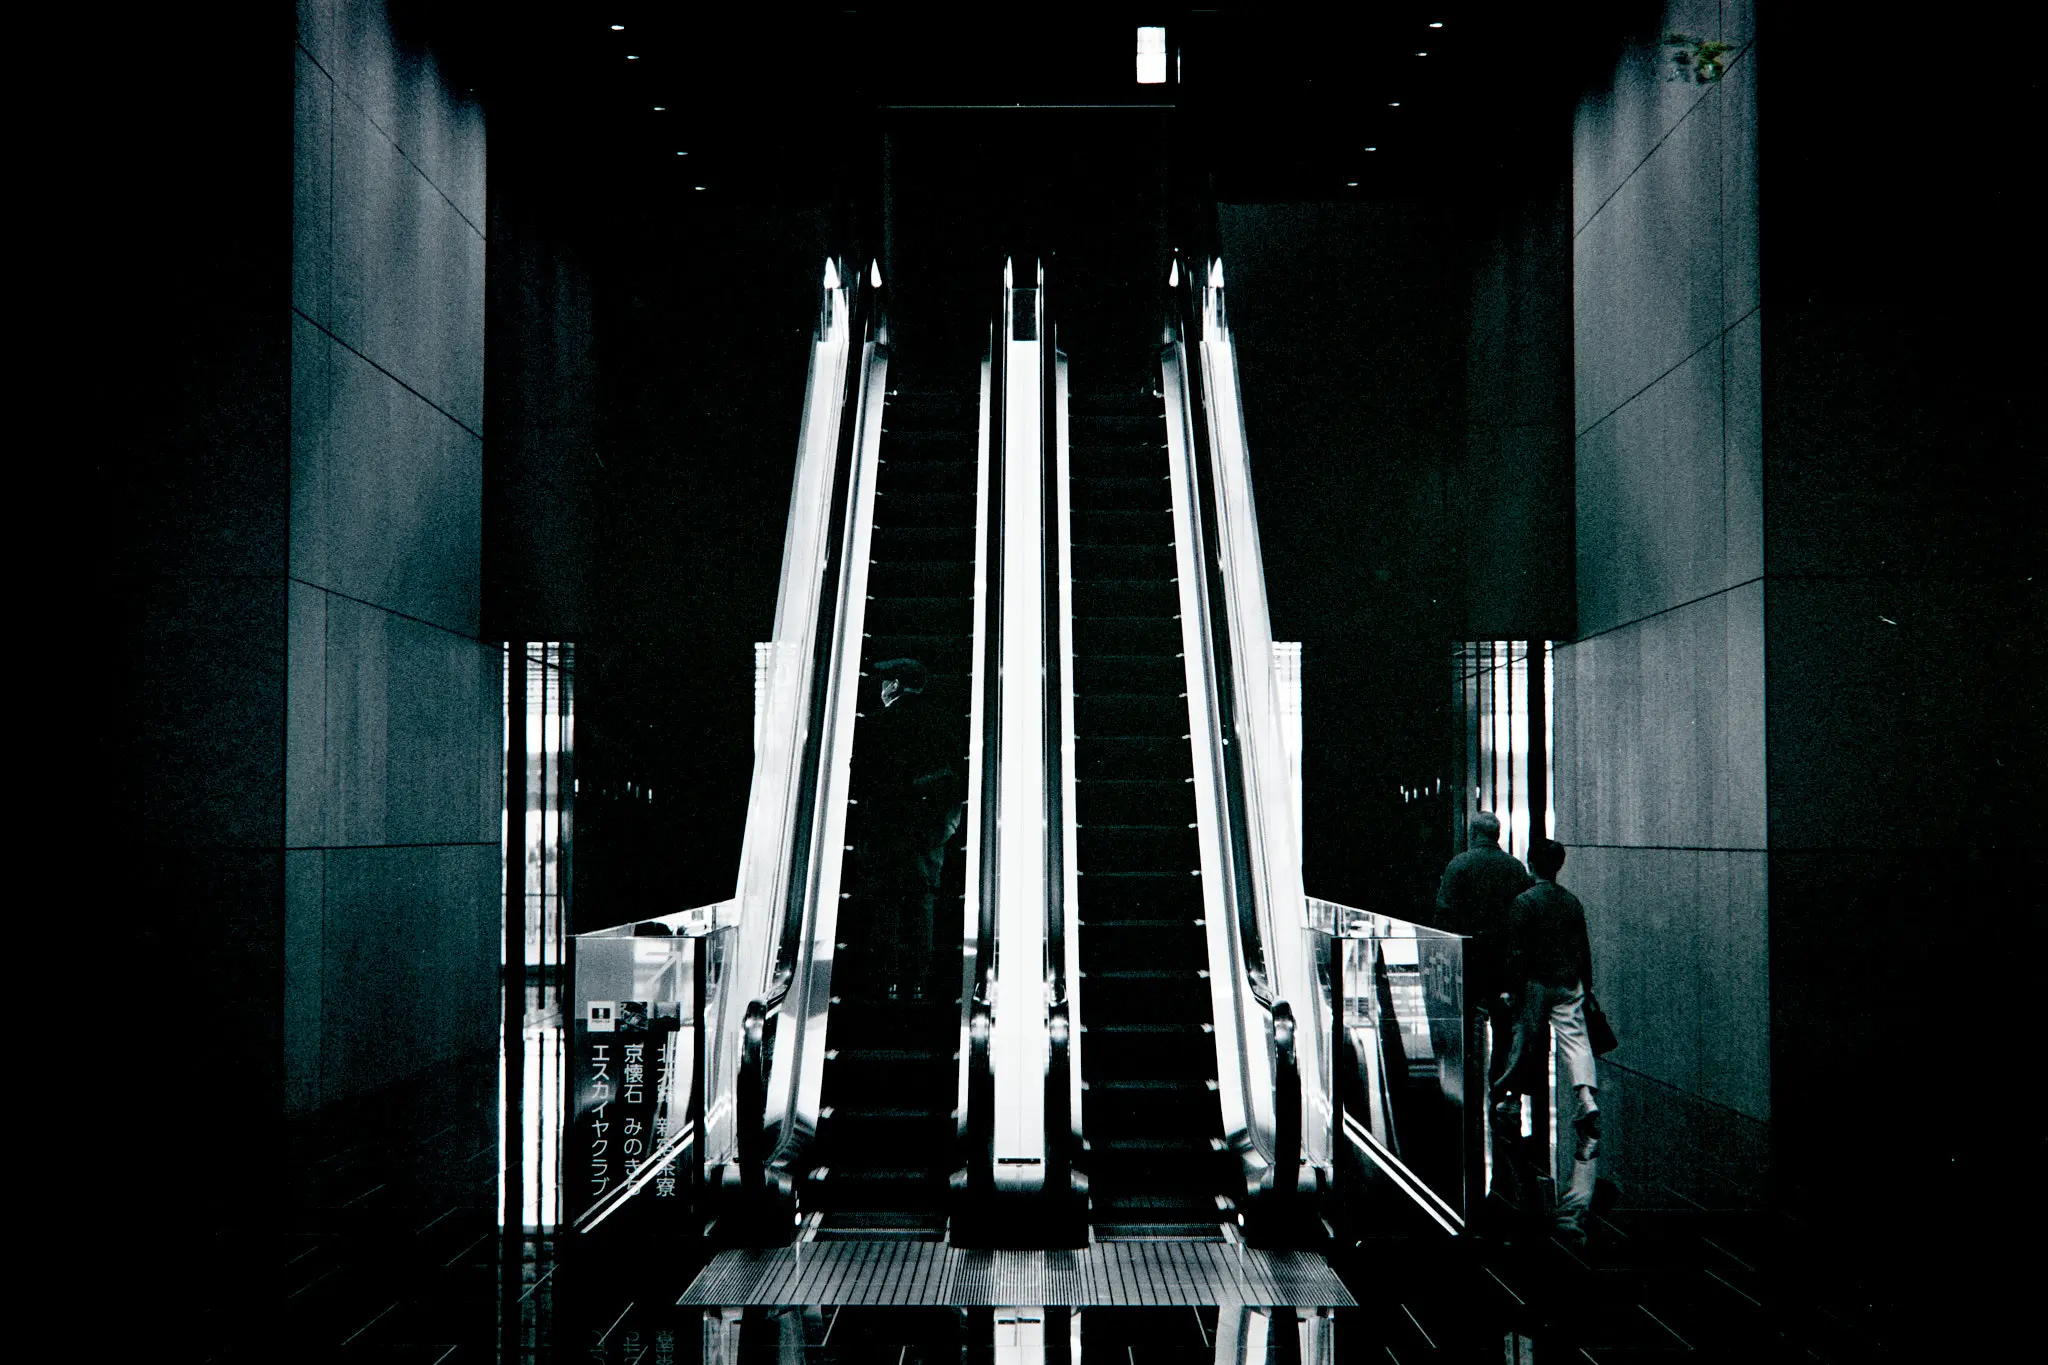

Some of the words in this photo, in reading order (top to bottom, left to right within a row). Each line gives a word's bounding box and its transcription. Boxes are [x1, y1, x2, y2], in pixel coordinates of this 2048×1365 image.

[591, 1045, 610, 1195] エスカイヤクラブ
[624, 1043, 643, 1103] 京懐石
